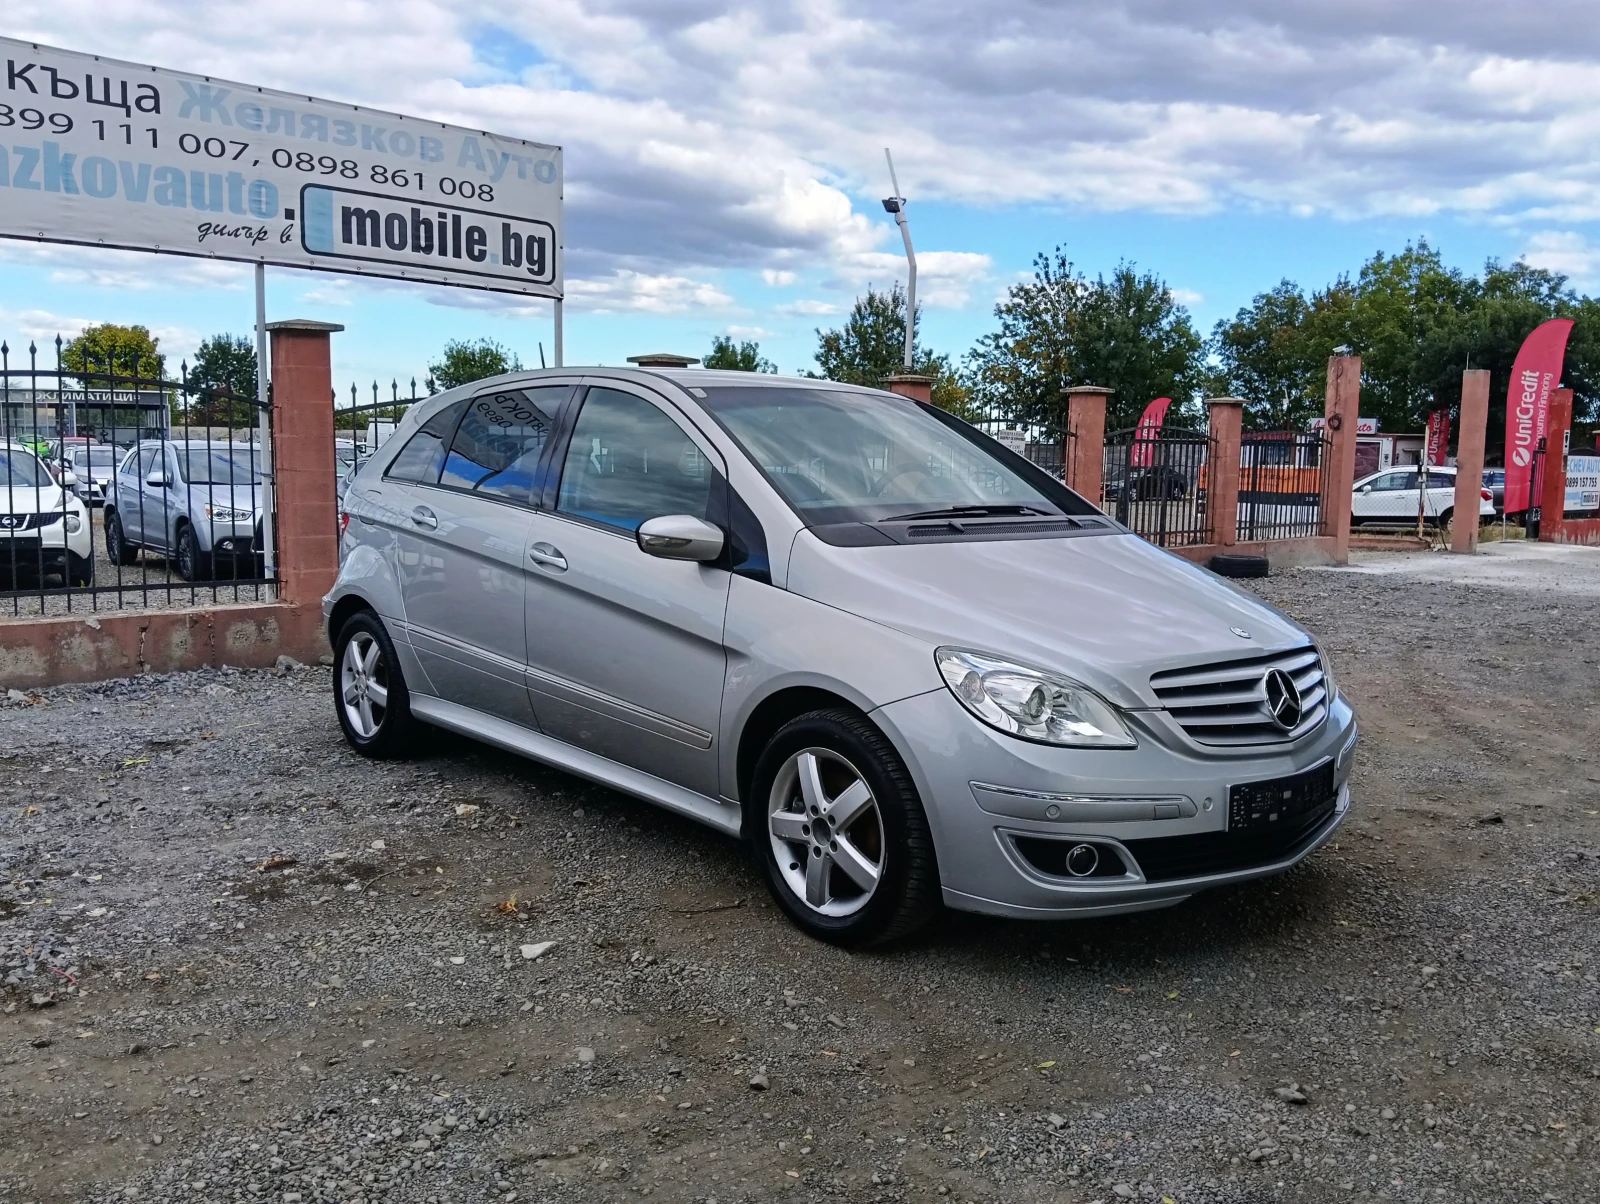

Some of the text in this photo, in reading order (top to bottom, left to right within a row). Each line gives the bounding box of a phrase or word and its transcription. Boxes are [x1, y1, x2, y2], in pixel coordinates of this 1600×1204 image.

[7, 59, 557, 184] къща Желязков Ауто
[92, 119, 158, 149] 111
[178, 133, 260, 167] 007,
[271, 148, 359, 179] 0898
[370, 164, 424, 191] 861
[438, 176, 495, 202] 008
[197, 222, 269, 246] дилър
[341, 205, 546, 277] mobile.bg
[1514, 369, 1540, 446] UniCredit
[1538, 372, 1554, 408] Financing
